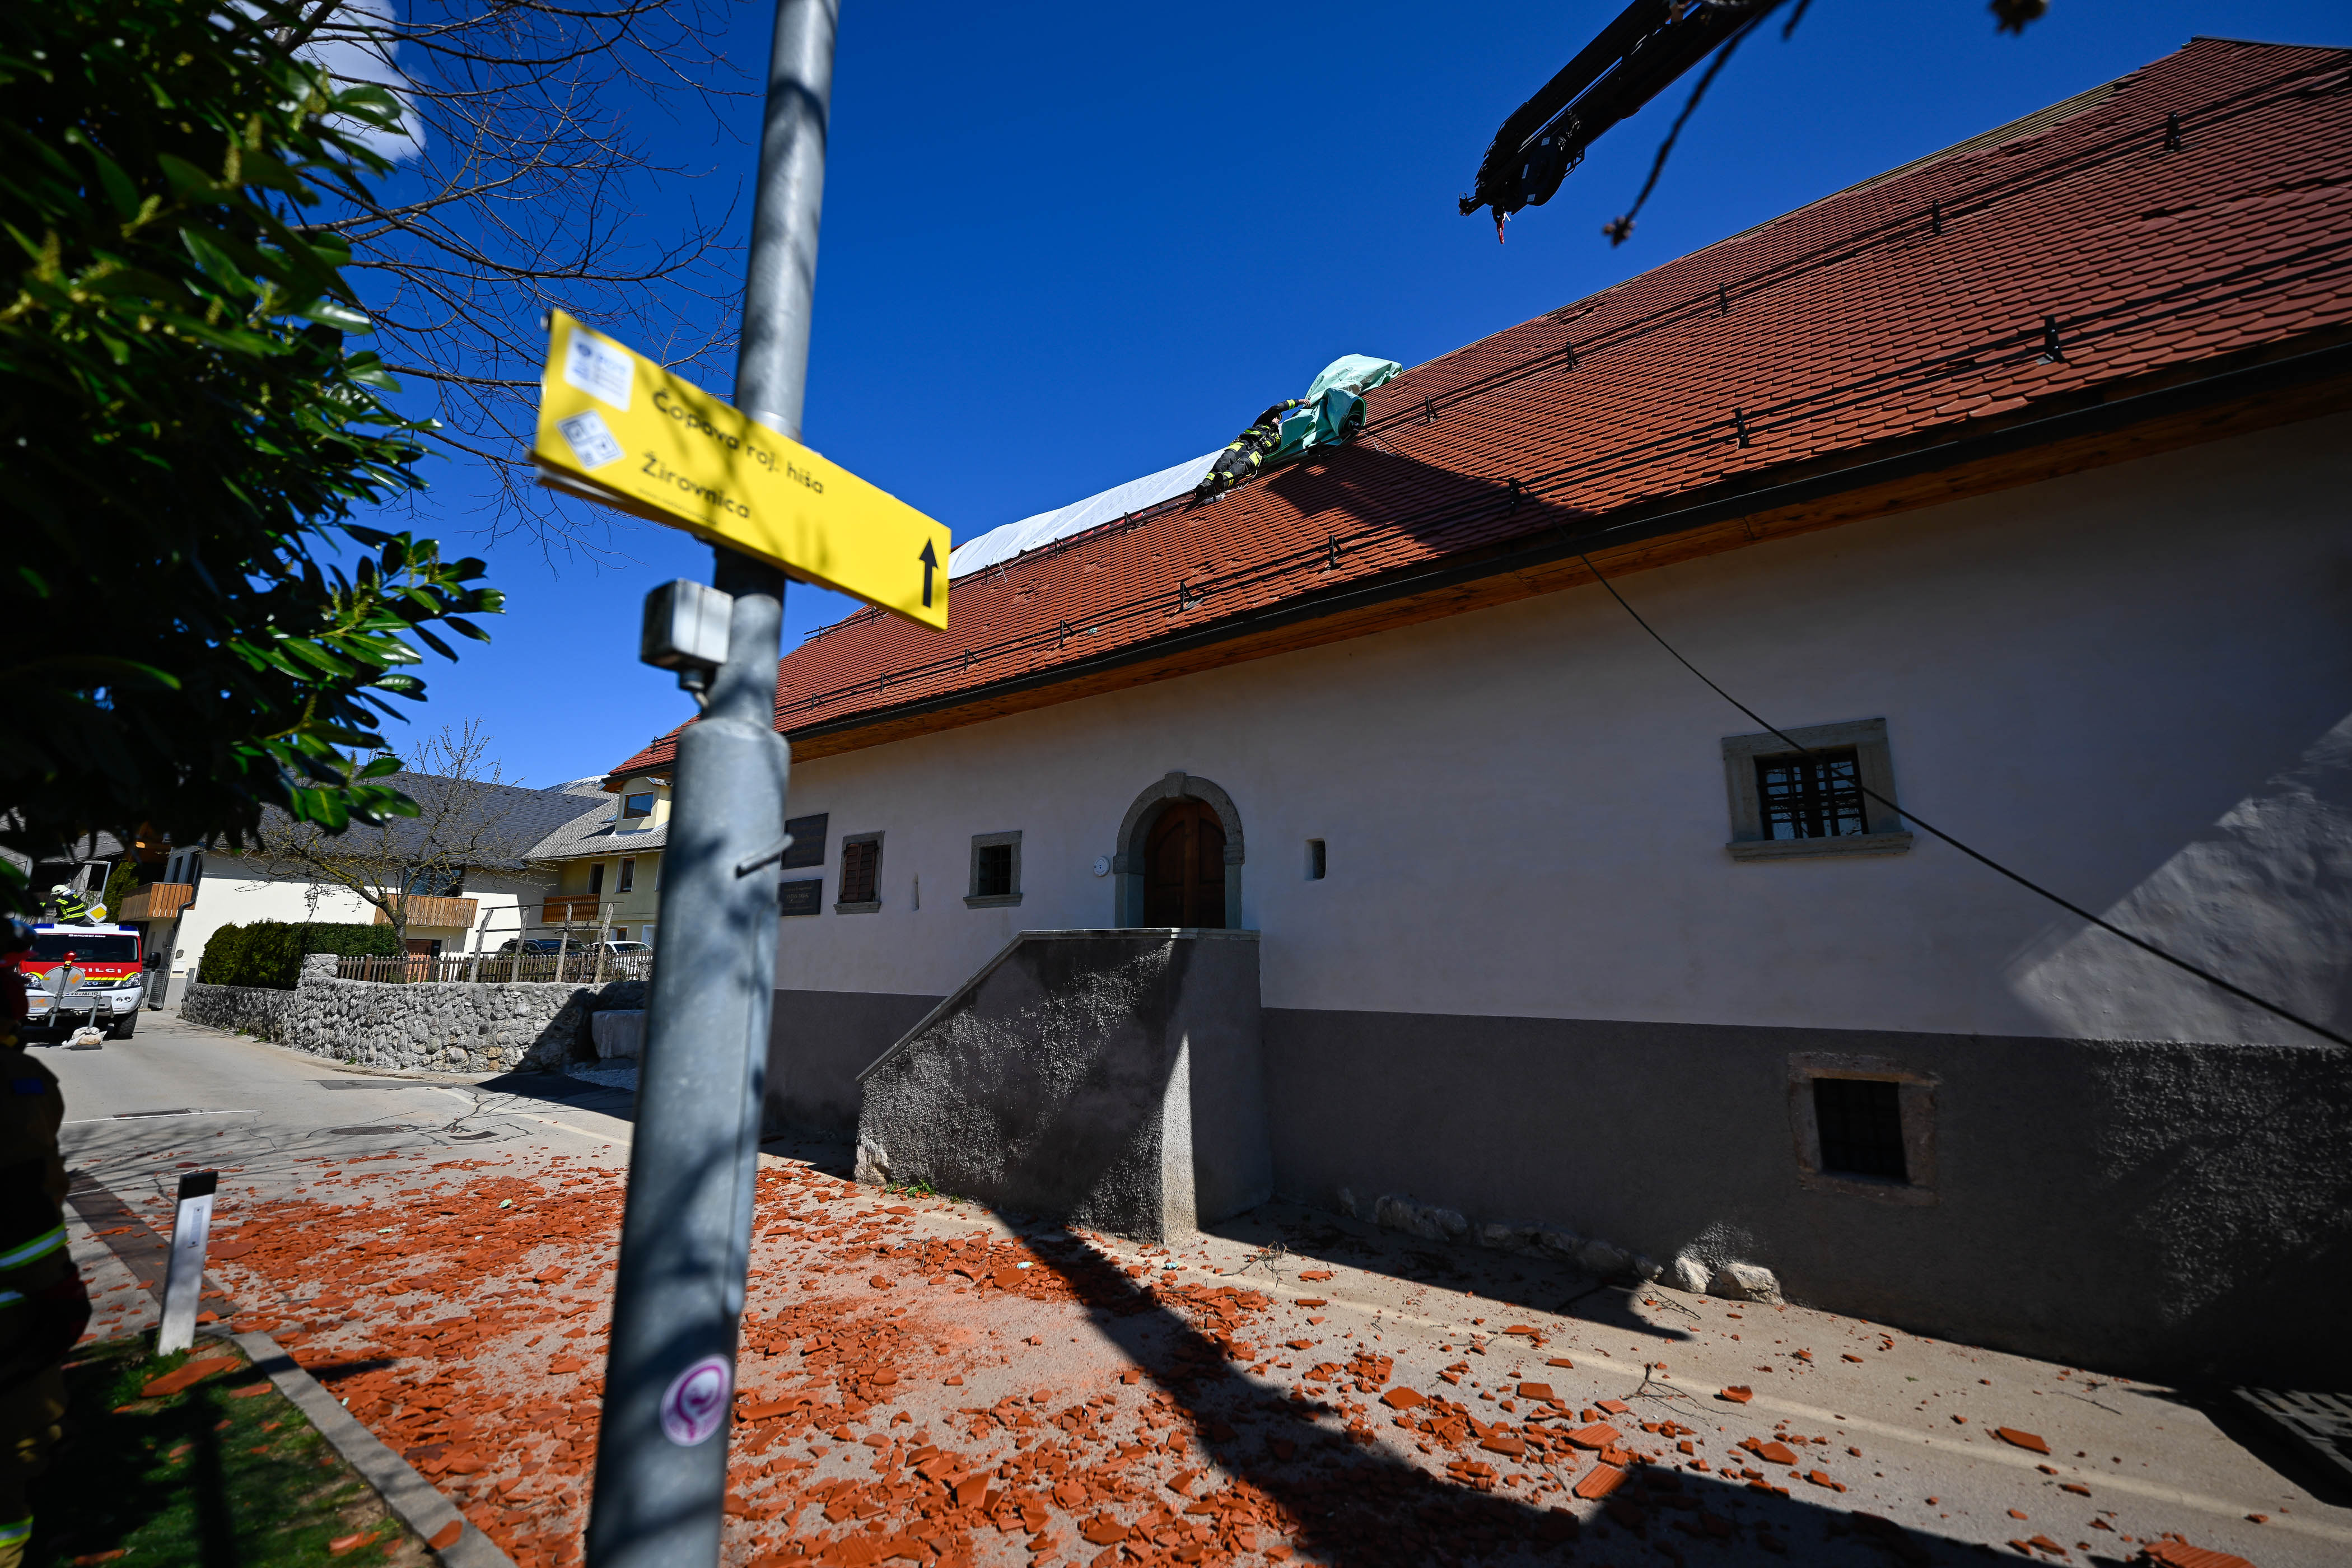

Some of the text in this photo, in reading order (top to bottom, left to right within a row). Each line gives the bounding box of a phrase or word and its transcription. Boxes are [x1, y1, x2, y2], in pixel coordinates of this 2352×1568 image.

[653, 388, 740, 450] Čopova
[787, 461, 824, 494] hiša
[642, 451, 750, 518] Žirovnica
